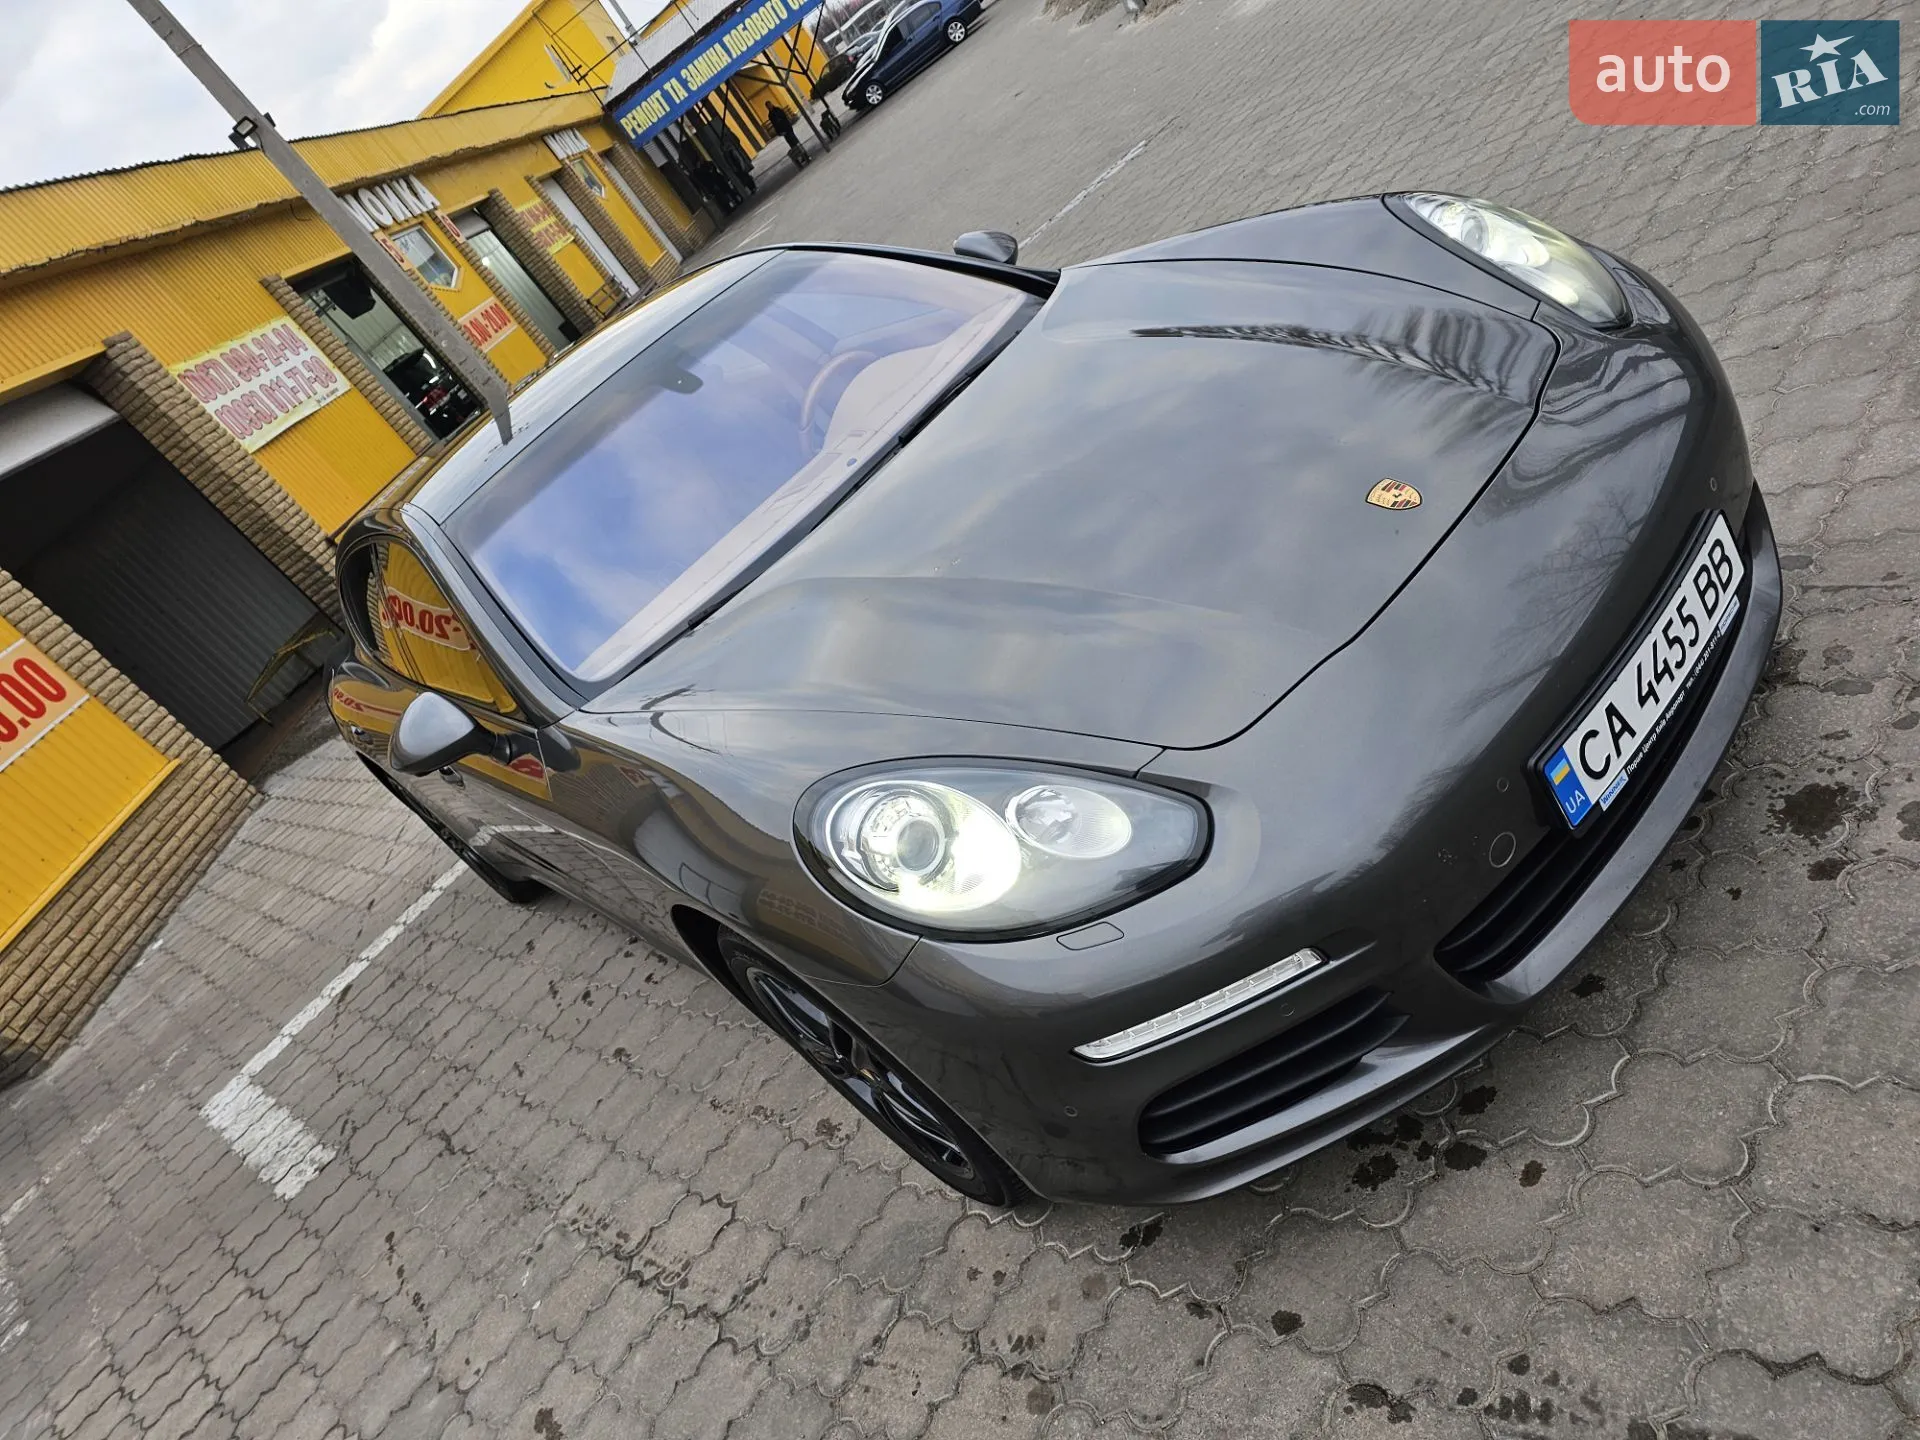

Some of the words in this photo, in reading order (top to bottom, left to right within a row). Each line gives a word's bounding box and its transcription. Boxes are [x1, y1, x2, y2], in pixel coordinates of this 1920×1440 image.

[619, 89, 671, 139] РЕМОНТ
[662, 77, 689, 104] ТА
[680, 42, 731, 91] ЗАМІНА
[722, 0, 788, 59] ЛОБОВОГО
[177, 358, 240, 404] (067)
[220, 323, 309, 382] 994-24-04
[214, 390, 278, 440] (093)
[1579, 701, 1637, 780] CA
[1635, 595, 1699, 709] 4455
[1693, 537, 1733, 620] BB
[1641, 732, 1657, 754] Центр
[1565, 789, 1586, 814] UA
